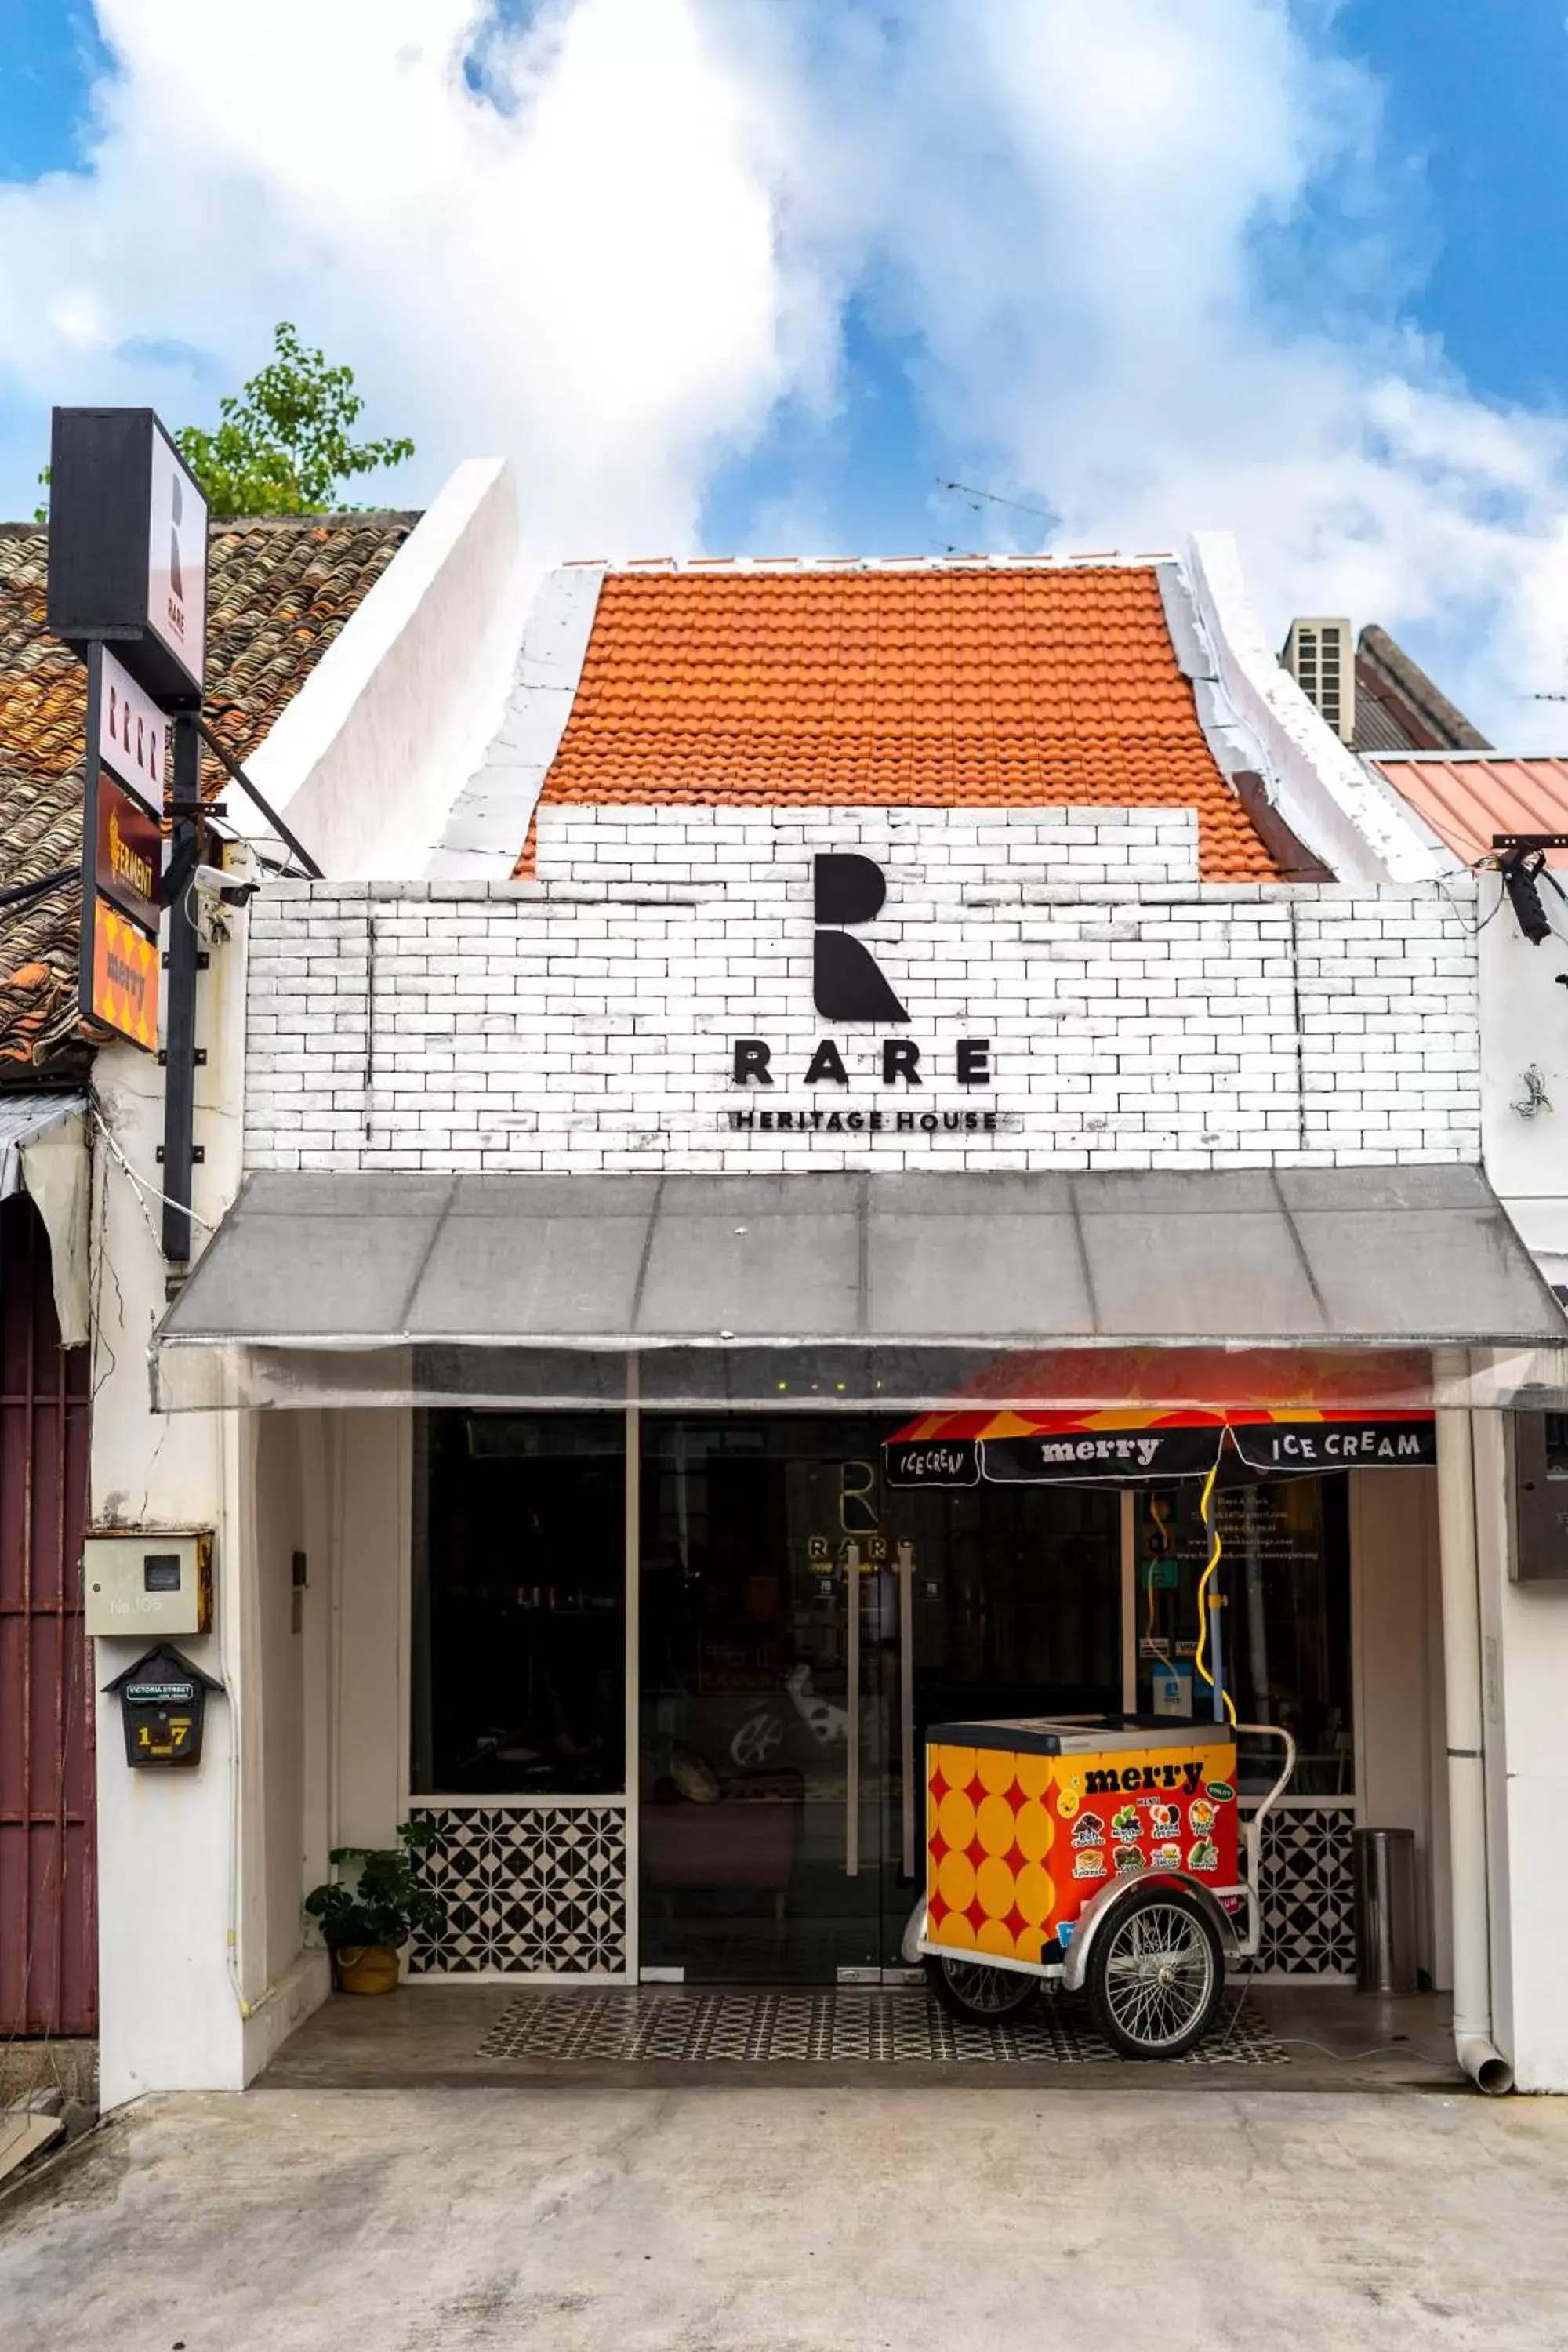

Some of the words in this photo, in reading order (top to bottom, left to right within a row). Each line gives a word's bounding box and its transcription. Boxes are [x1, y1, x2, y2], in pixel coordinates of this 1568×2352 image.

[107, 952, 146, 1011] merry
[734, 1039, 991, 1085] RARE
[736, 1111, 883, 1131] HERITAGE
[897, 1111, 997, 1131] HOUSE
[1042, 1439, 1160, 1465] merry
[1272, 1434, 1317, 1460] ICE
[1325, 1431, 1421, 1457] CREAM
[1085, 1761, 1204, 1795] merry
